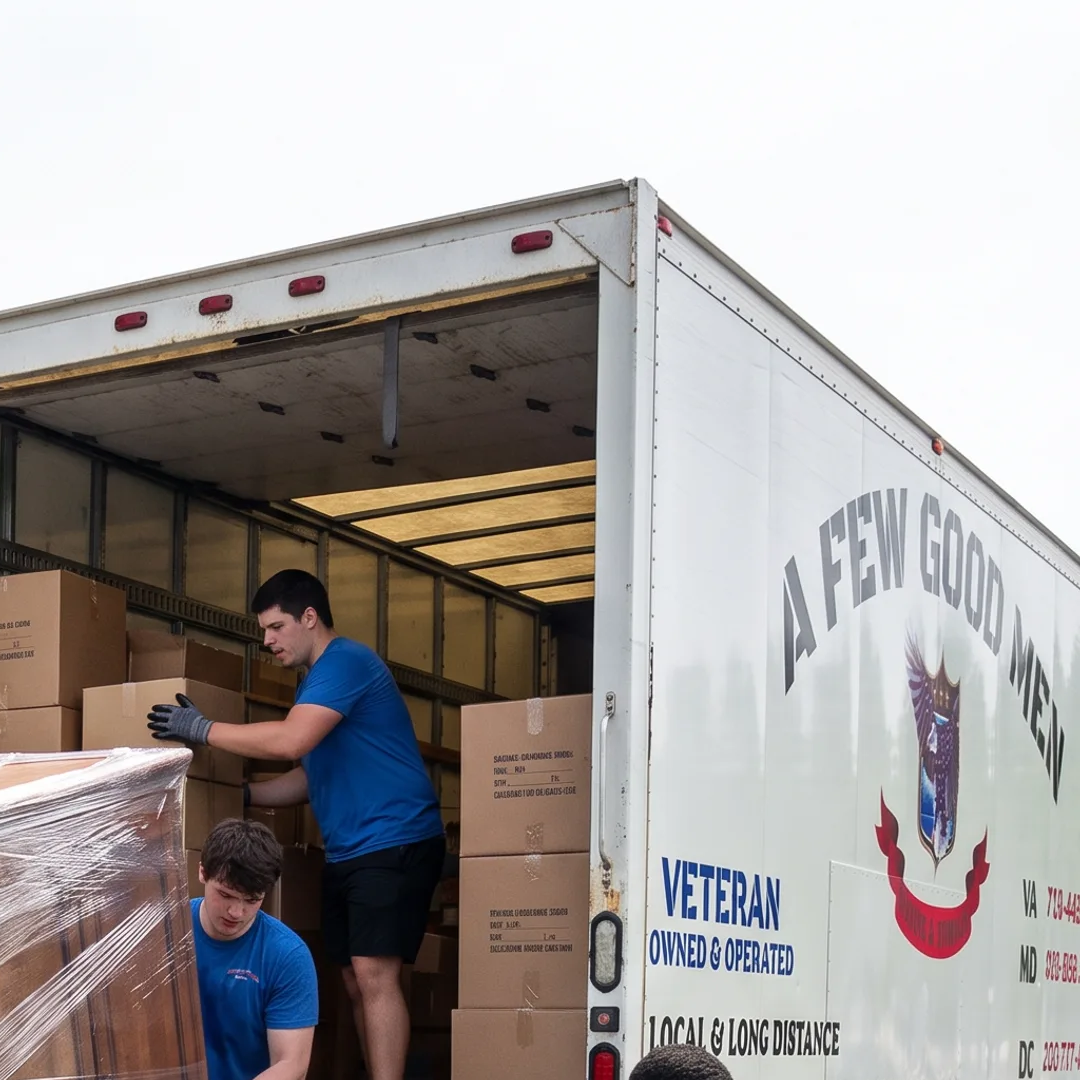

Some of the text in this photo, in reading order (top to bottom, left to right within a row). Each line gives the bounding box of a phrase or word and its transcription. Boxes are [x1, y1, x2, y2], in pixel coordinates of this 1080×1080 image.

[783, 487, 1065, 805] A FEW GOOD MEN
[661, 856, 781, 931] VETERAN
[1022, 878, 1037, 919] VA
[649, 929, 795, 976] OWNED & OPERATED
[1019, 944, 1037, 984] MD
[649, 1015, 840, 1057] LOCAL & LONG DISTANCE
[1018, 1040, 1035, 1079] DC
